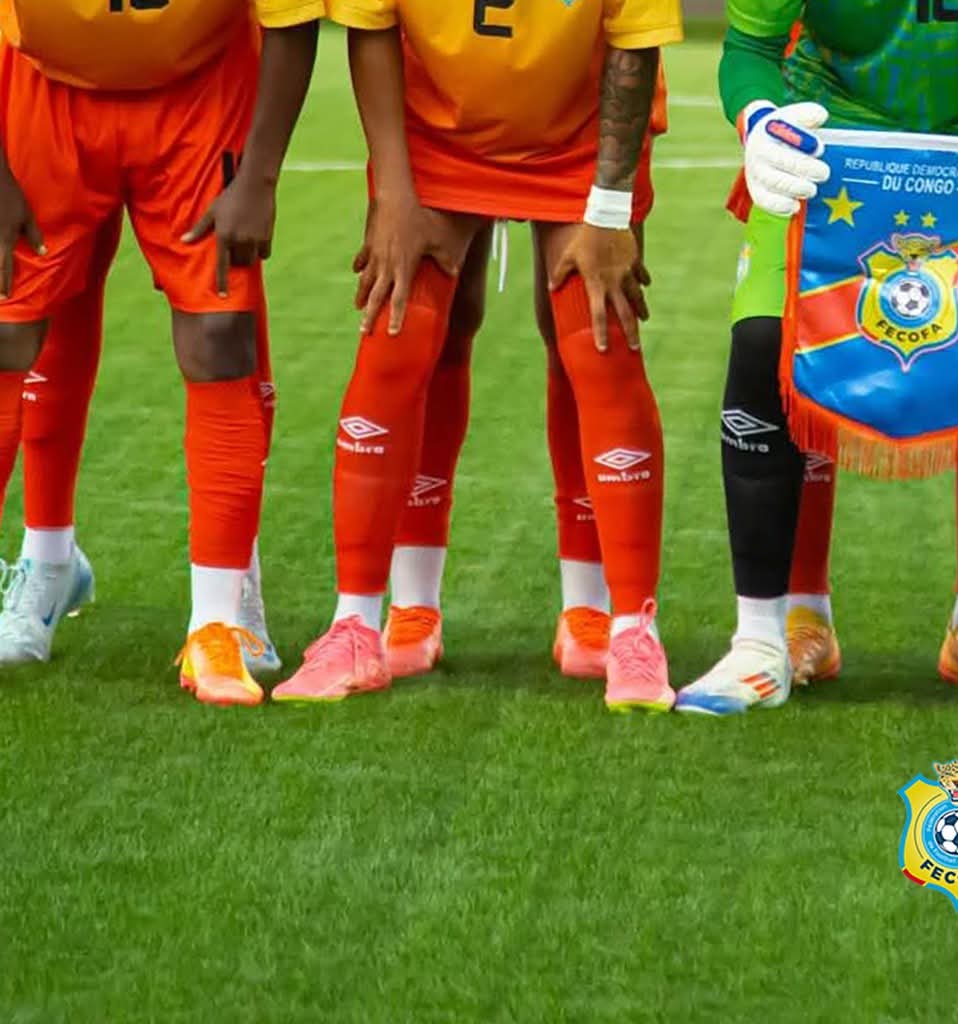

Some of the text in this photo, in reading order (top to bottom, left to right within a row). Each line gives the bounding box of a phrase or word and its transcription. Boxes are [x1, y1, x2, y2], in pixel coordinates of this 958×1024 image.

[882, 174, 954, 195] DU CONGO
[875, 319, 943, 343] FECOFA
[597, 470, 650, 483] umbro
